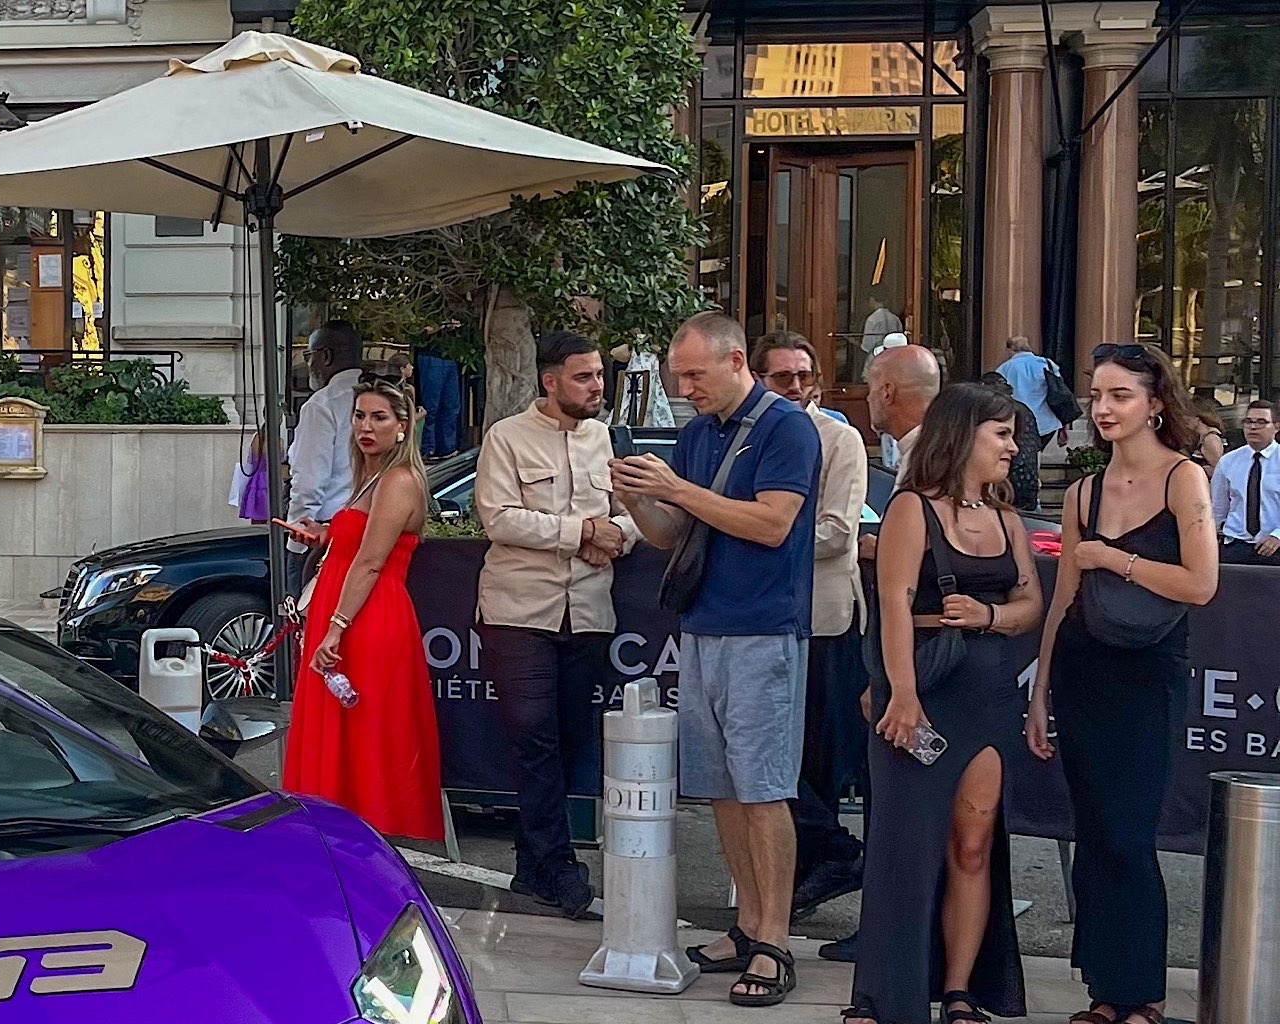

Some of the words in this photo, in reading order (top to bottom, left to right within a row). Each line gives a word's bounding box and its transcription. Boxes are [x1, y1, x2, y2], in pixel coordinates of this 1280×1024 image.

[752, 110, 820, 133] HOTEL
[429, 674, 499, 700] IÉTE
[1186, 726, 1228, 753] ES
